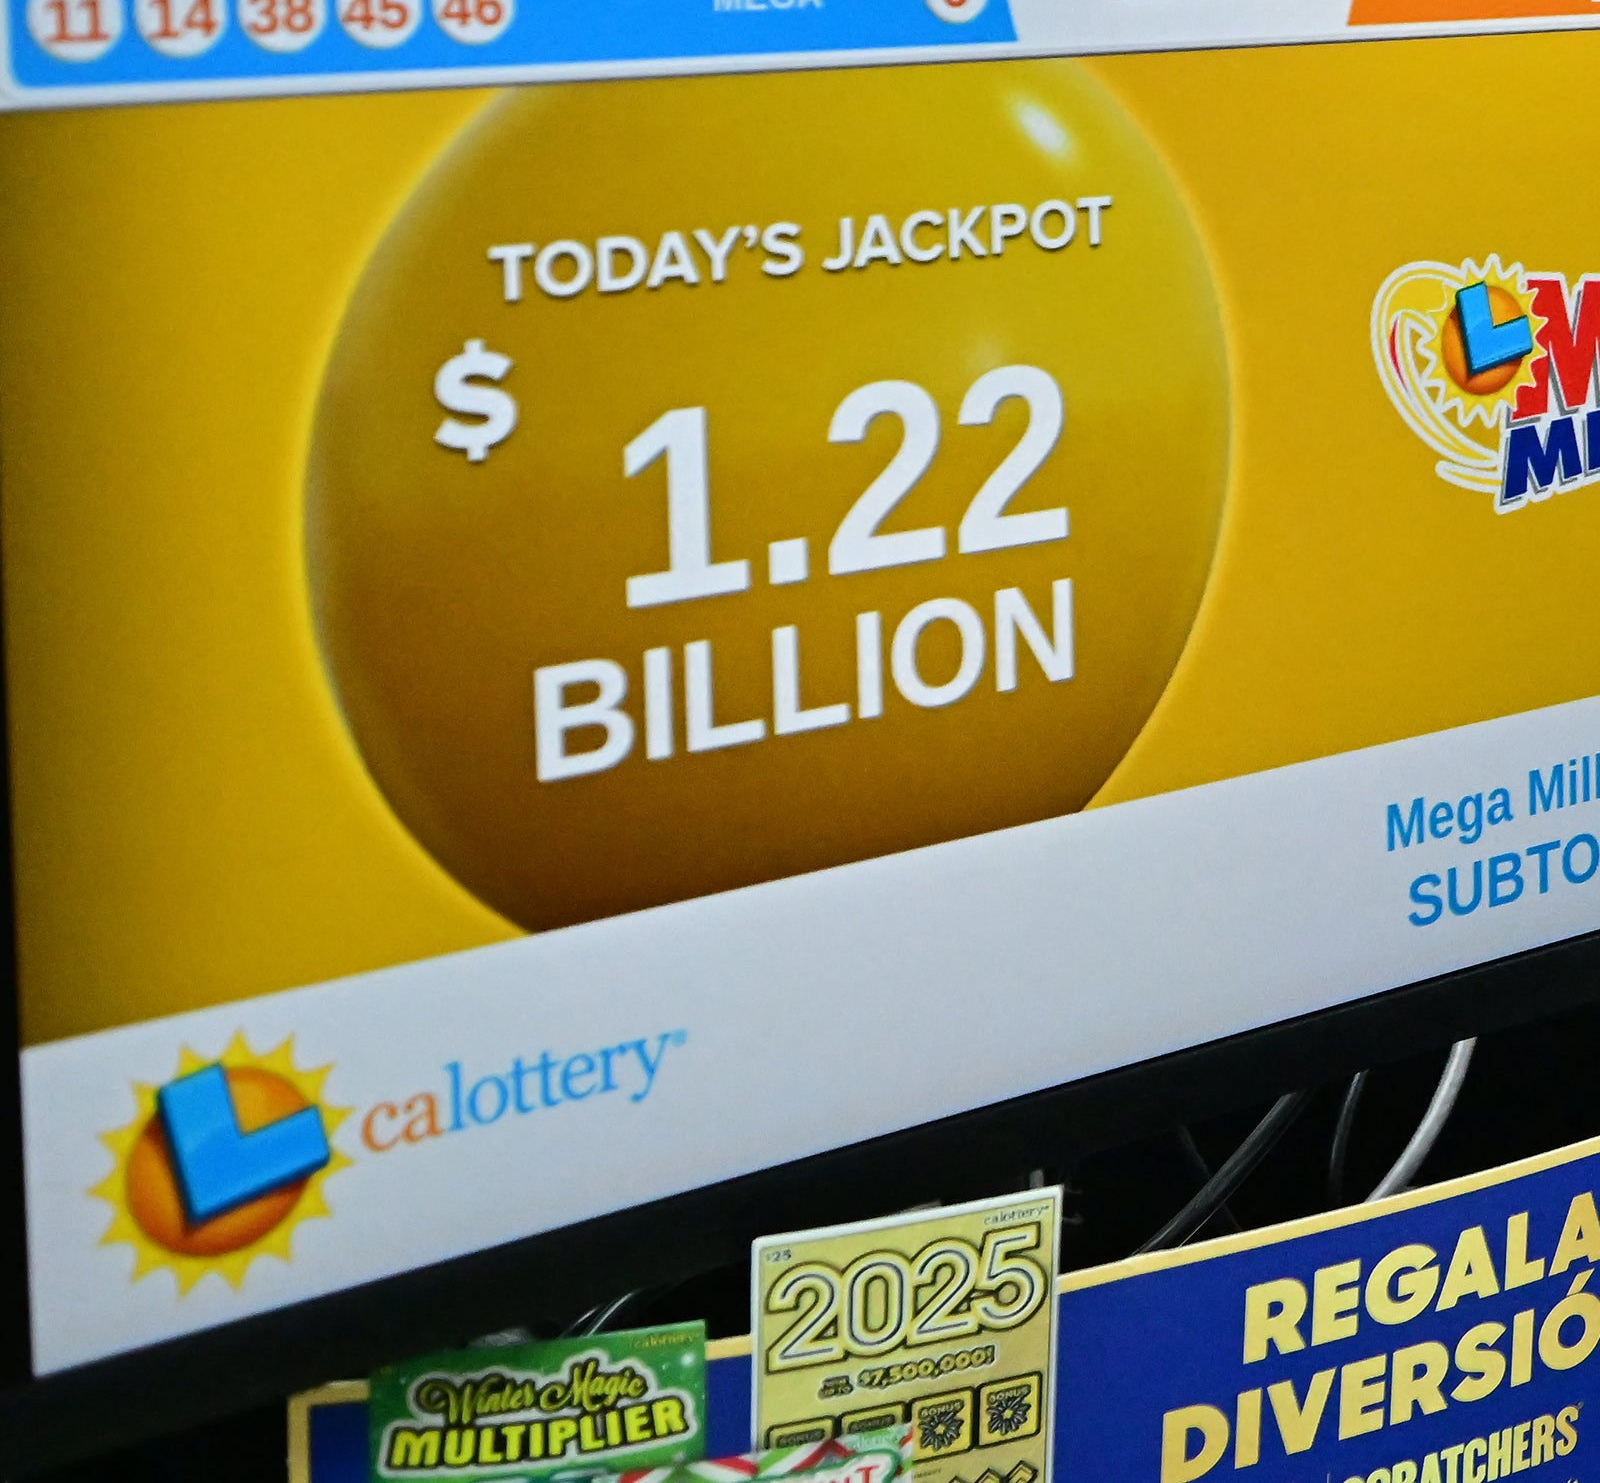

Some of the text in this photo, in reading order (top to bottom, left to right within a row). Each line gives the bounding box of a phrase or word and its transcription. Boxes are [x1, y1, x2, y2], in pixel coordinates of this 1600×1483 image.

[488, 196, 1113, 303] TODAY’S JACKPOT
[433, 339, 518, 461] $
[623, 364, 1071, 608] 1.22
[533, 578, 1074, 783] BILLION
[1385, 787, 1513, 851] Mega
[361, 1036, 671, 1153] calottery
[984, 1204, 1045, 1225] calottery
[766, 1222, 1048, 1375] 2025
[415, 1357, 648, 1425] Winter Magic
[857, 1346, 996, 1388] $7,500,000!
[920, 1400, 963, 1418] BONUS
[988, 1383, 1031, 1404] BONUS
[391, 1396, 690, 1467] MULTIPLIER
[1343, 1405, 1580, 1483] RATCHERS
